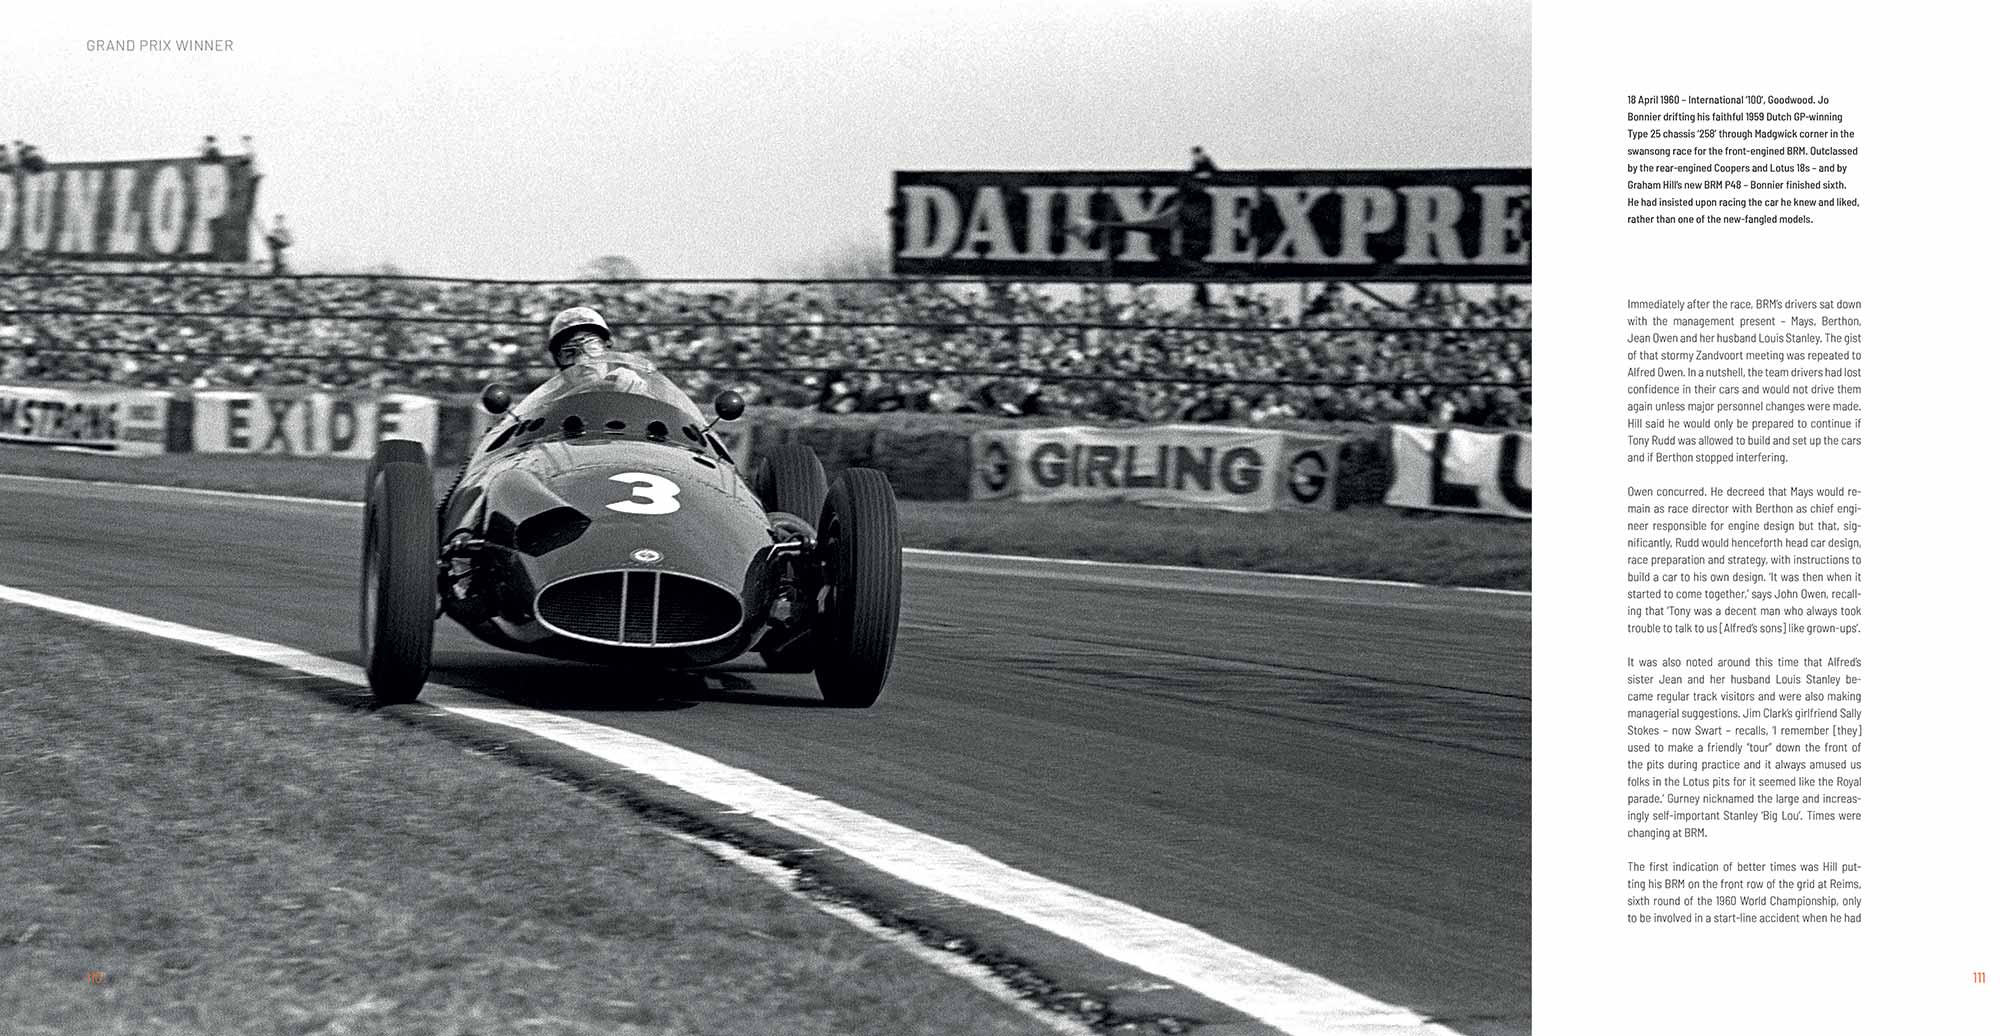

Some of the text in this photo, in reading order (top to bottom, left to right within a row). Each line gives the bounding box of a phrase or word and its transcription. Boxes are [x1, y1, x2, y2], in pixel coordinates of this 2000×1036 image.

[1627, 94, 1637, 105] 18
[1637, 95, 1659, 107] April
[1659, 94, 1680, 105] 1960
[1688, 95, 1744, 105] International
[1767, 95, 1816, 105] Goodwood.
[1817, 95, 1830, 105] Jo
[1627, 111, 1843, 124] Bonnier drifting his faithful 1959 Dutch GP-winning
[1627, 128, 1649, 141] Type
[1649, 128, 1662, 139] 25
[1662, 128, 1696, 139] chassis
[1718, 128, 1753, 141] through
[1754, 128, 1798, 141] Madgwick
[1799, 130, 1829, 139] corner
[1829, 128, 1839, 139] in
[1839, 129, 1855, 139] the
[1627, 146, 1859, 158] swansong race for the front-engined BRM. Outclassed
[1627, 163, 1638, 175] by
[1639, 163, 1655, 173] the
[1655, 163, 1713, 175] rear-engined
[1713, 163, 1751, 175] Coopers
[1751, 163, 1768, 173] and
[1769, 163, 1795, 173] Lotus
[1796, 162, 1811, 173] 18s
[1818, 163, 1836, 173] and
[1836, 163, 1848, 175] by
[1627, 180, 1662, 190] Graham
[1683, 182, 1703, 190] new
[1703, 180, 1723, 190] BRM
[1724, 179, 1742, 190] P48
[1750, 180, 1785, 190] Bonnier
[1785, 180, 1821, 190] finished
[1822, 180, 1847, 190] sixth.
[1627, 197, 1860, 209] He had insisted upon racing the car he knew and liked,
[901, 185, 1532, 265] DAILY EXPRE
[1627, 214, 1814, 226] rather than one of the new-fangled models.
[1627, 299, 1685, 312] Immediately
[1686, 298, 1711, 310] after
[1712, 299, 1728, 310] the
[1730, 301, 1753, 310] race,
[1784, 298, 1818, 310] drivers
[1819, 299, 1835, 310] sat
[1836, 299, 1862, 310] down
[1627, 383, 1862, 395] confidence in their cars and would not drive them
[1627, 401, 1862, 414] again unless major personnel changes were made.
[1627, 451, 1789, 465] and if Berthon stopped interfering.
[1031, 442, 1262, 495] GIRLING
[605, 472, 681, 515] 3
[1627, 486, 1861, 499] Owen concurred. He decreed that Mays would re-
[1627, 537, 1862, 551] nificantly, Rudd would henceforth head car design,
[1627, 554, 1862, 568] race preparation and strategy, with instructions to
[1627, 691, 1862, 704] came regular track visitors and were also making
[1627, 827, 1708, 841] changing at BRM.
[1627, 895, 1862, 909] sixth round of the 1960 World Championship, only
[1972, 971, 1986, 984] 111
